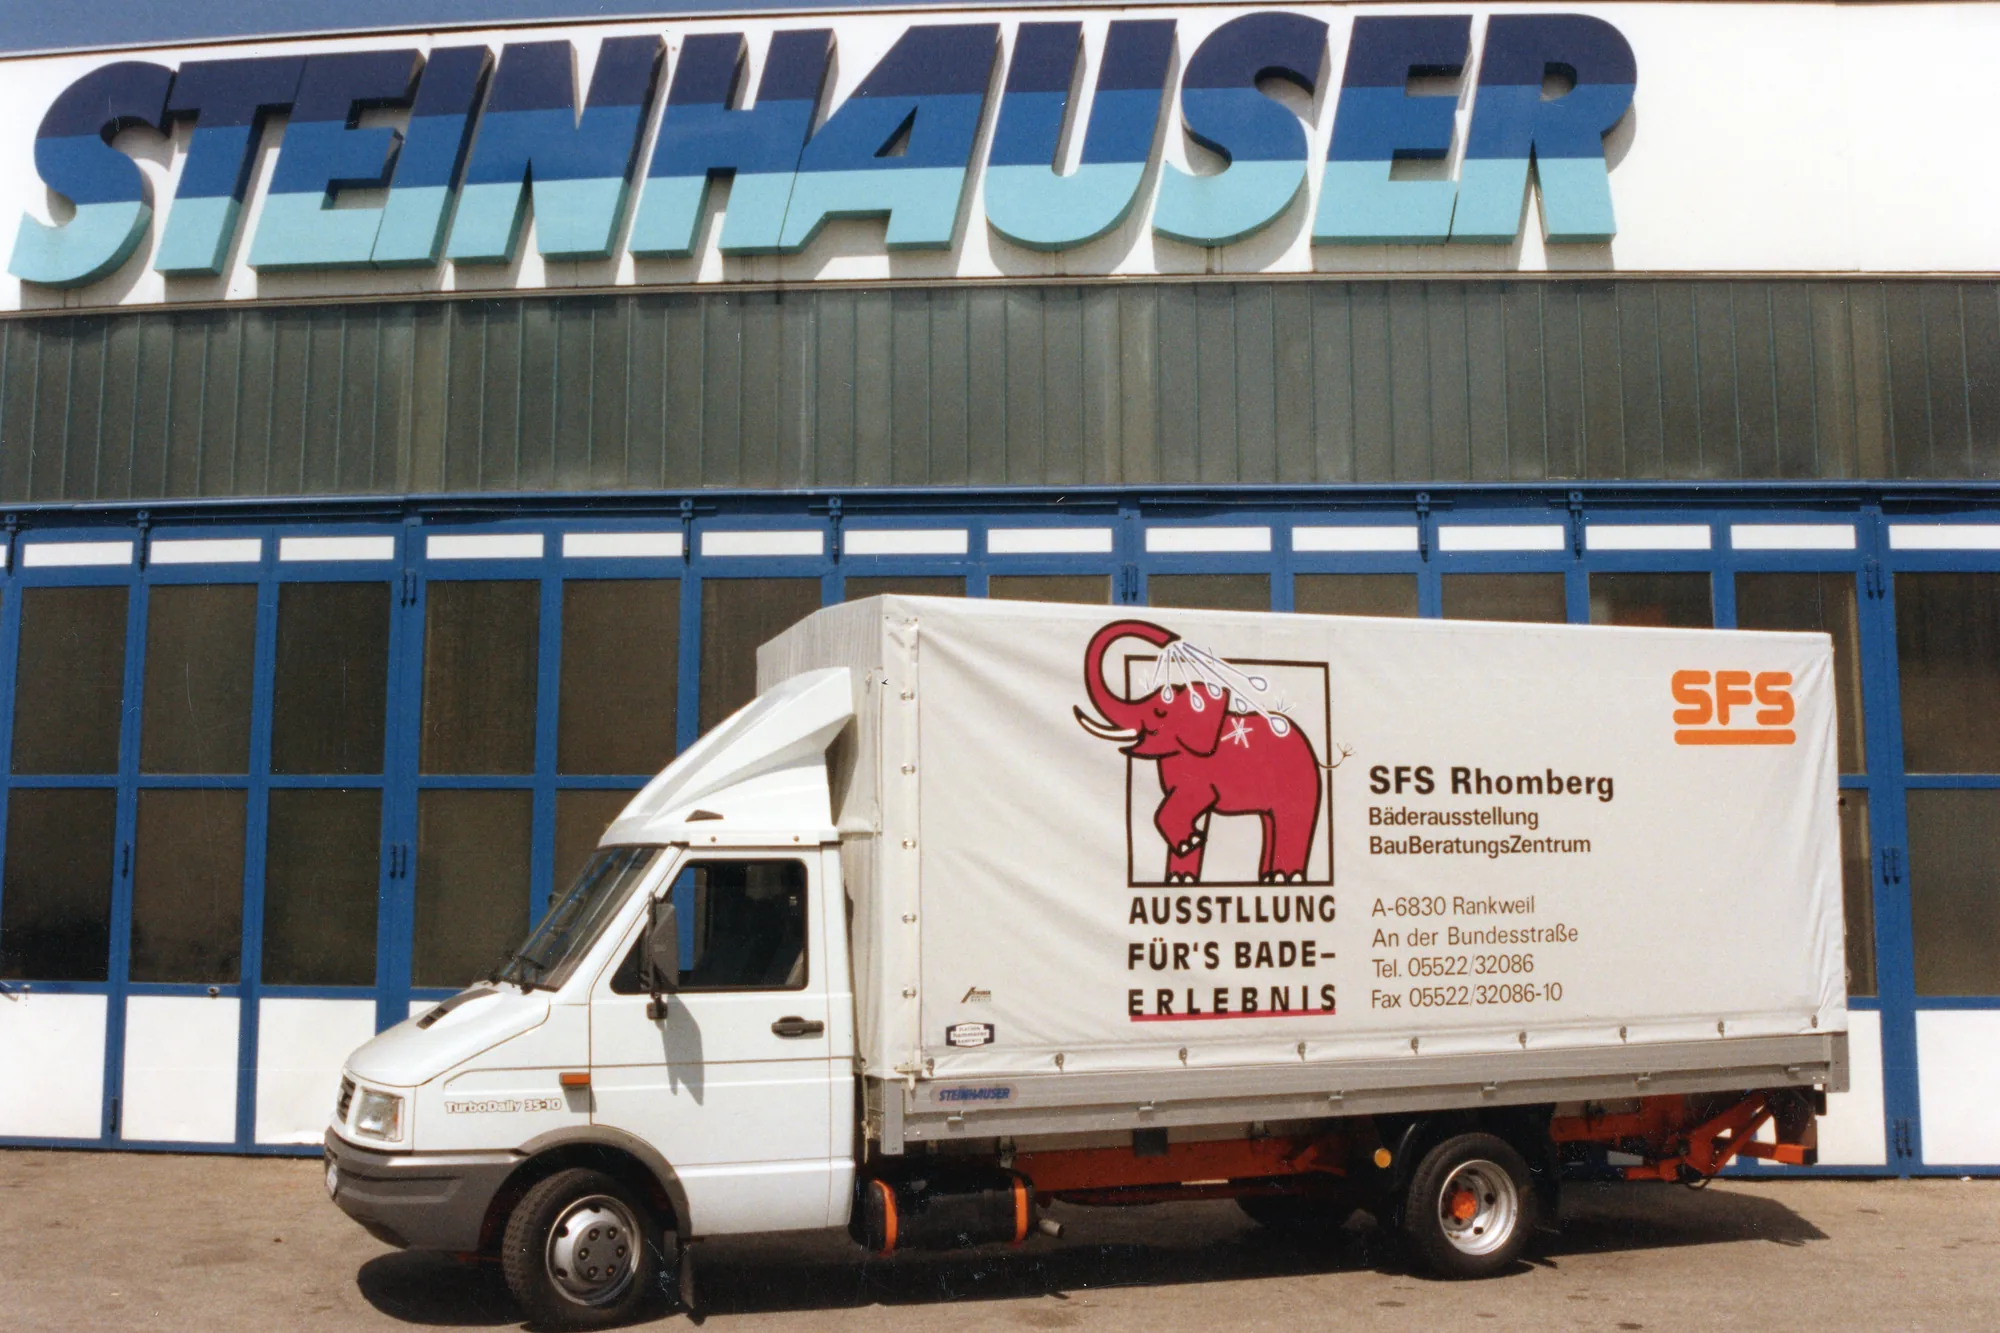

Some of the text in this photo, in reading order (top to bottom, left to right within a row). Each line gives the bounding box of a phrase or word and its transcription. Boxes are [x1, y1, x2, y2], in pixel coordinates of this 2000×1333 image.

[8, 11, 1638, 287] STEINHAUSER
[1671, 670, 1795, 726] SFS
[1369, 765, 1614, 802] SFS Rhomberg
[1369, 806, 1539, 830] Bäderausstellung
[1369, 835, 1591, 859] BauBeratungsZentrum
[1128, 895, 1336, 925] AUSSTLLUNG
[1372, 896, 1535, 917] A-6830 Rankweil
[1372, 923, 1579, 948] An der Bundesstraße
[1234, 940, 1336, 969] BADE-
[1372, 954, 1534, 978] Tel. 05522/32086
[1128, 984, 1336, 1016] ERLEBNIS
[1371, 982, 1563, 1009] Fax 05522/32086-10
[445, 1100, 521, 1114] TurboDaily
[939, 1088, 1010, 1102] STEINHAUSER
